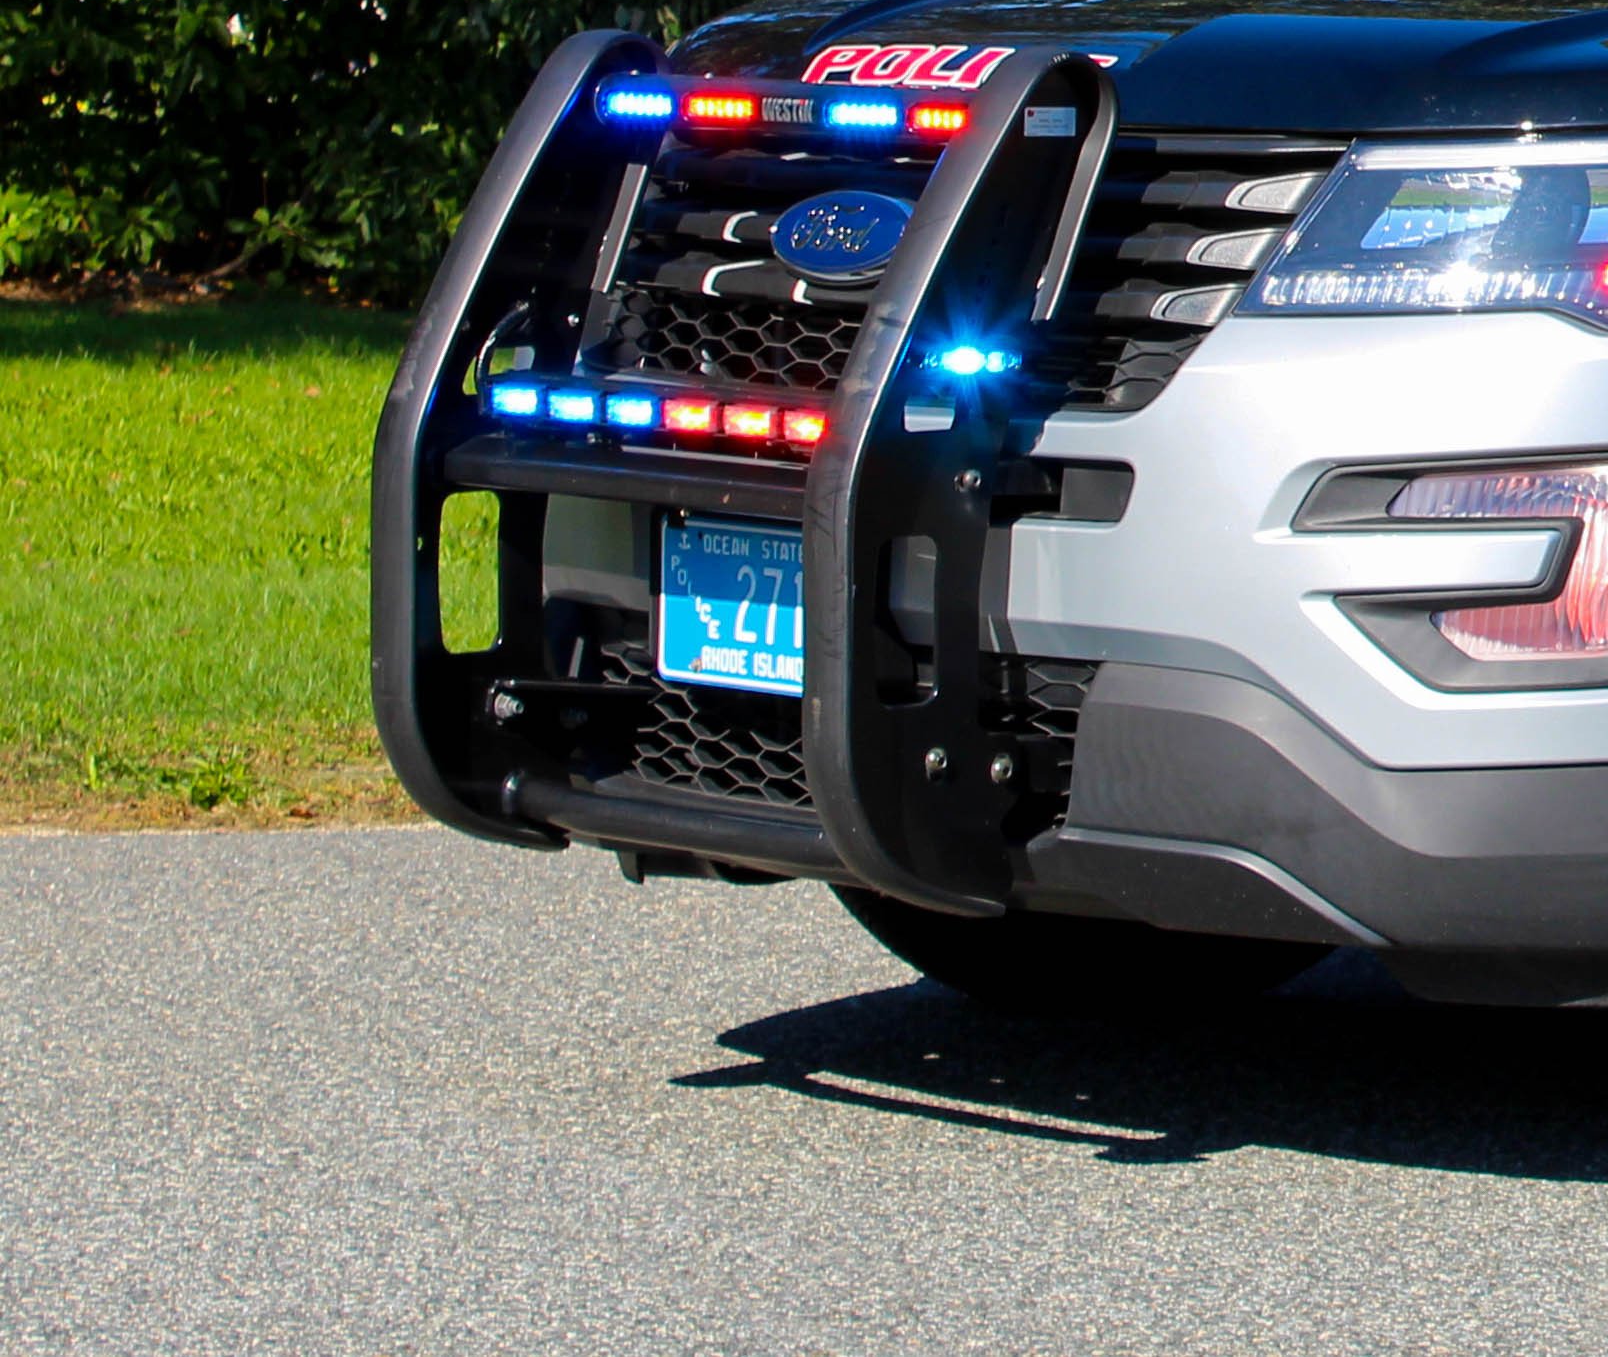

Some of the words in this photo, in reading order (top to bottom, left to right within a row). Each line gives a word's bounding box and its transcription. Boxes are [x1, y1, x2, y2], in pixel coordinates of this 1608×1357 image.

[801, 45, 1118, 90] POLI
[791, 204, 880, 252] Ford
[702, 533, 750, 557] OCEAN
[671, 554, 721, 640] POLICE
[701, 645, 749, 675] RHODE
